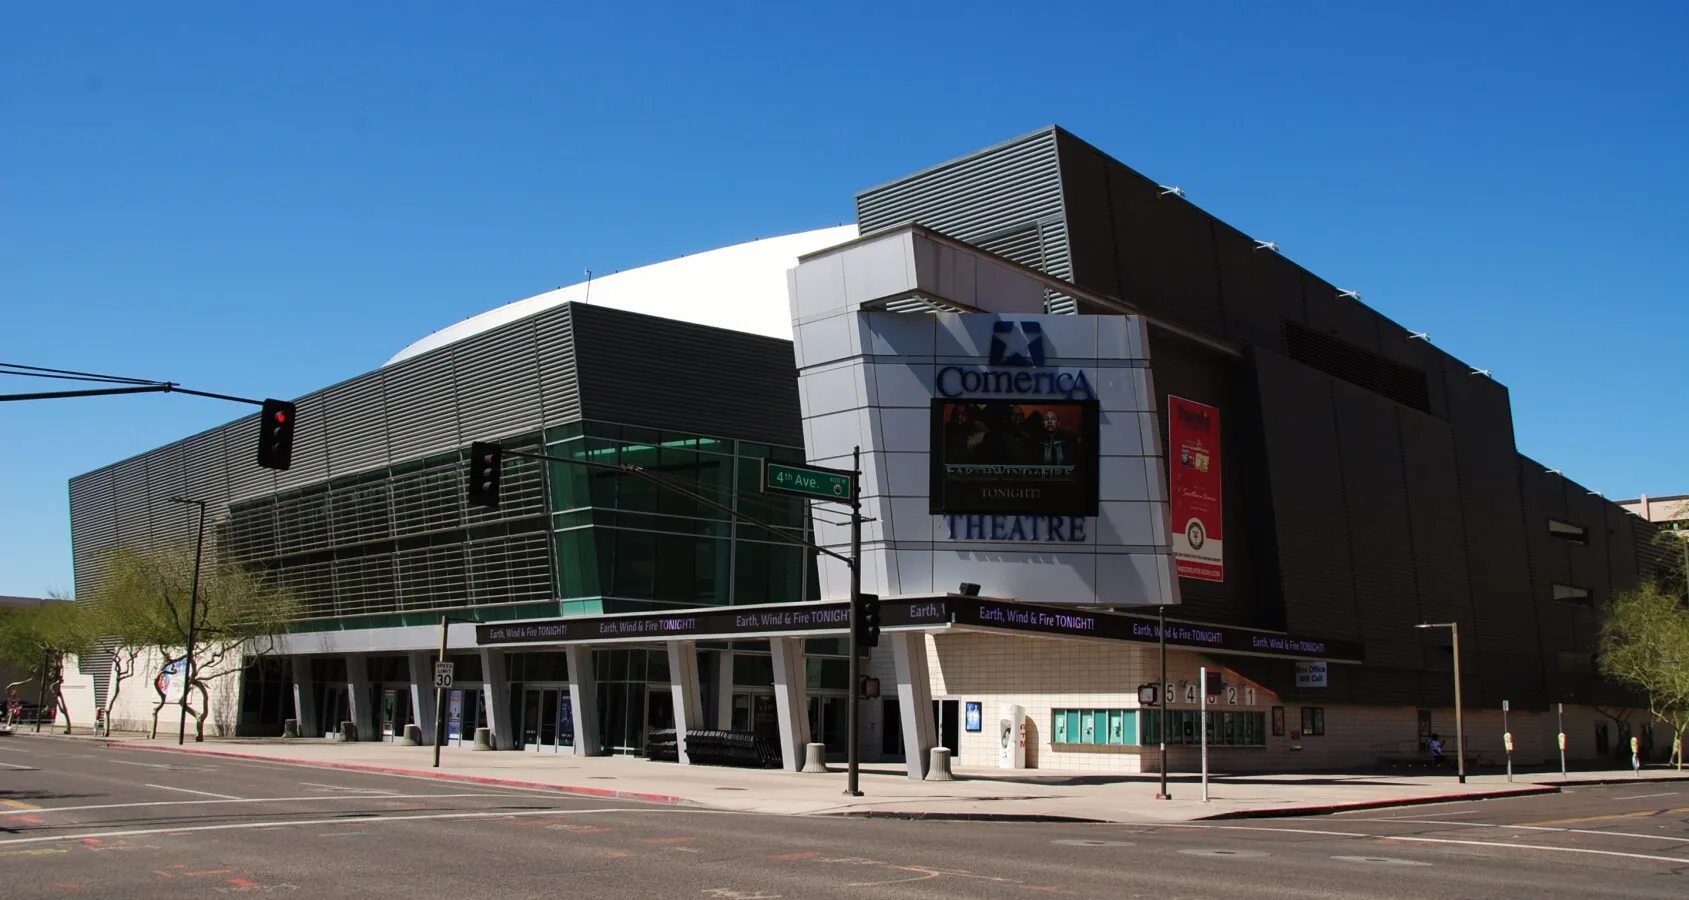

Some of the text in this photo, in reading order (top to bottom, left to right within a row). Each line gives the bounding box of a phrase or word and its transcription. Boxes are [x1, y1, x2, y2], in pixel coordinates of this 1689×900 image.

[776, 471, 820, 488] 4th Ave.
[981, 488, 1040, 498] TONIGHT!
[944, 513, 1086, 541] THEATRE
[910, 603, 939, 618] Earth,
[979, 606, 1094, 630] Earth, Wind & Fire TONIGHT!
[600, 618, 695, 634] Earth, Wind & Fire TONIGHT!
[736, 613, 759, 627] Earth,
[761, 612, 782, 625] Wind
[784, 613, 791, 624] &
[794, 611, 809, 623] Fire
[490, 624, 567, 639] Earth, Wind & Fire TONIGHT!
[1133, 623, 1223, 643] Earth, Wnd & Fire TONIGHT!
[1269, 638, 1283, 649] Wind
[1290, 640, 1300, 651] Fire
[1300, 641, 1325, 653] TONIGHT!
[1308, 665, 1325, 673] Office
[436, 674, 451, 686] 30
[1166, 684, 1174, 702] 5
[1187, 686, 1194, 702] 4
[1229, 687, 1236, 704] 2
